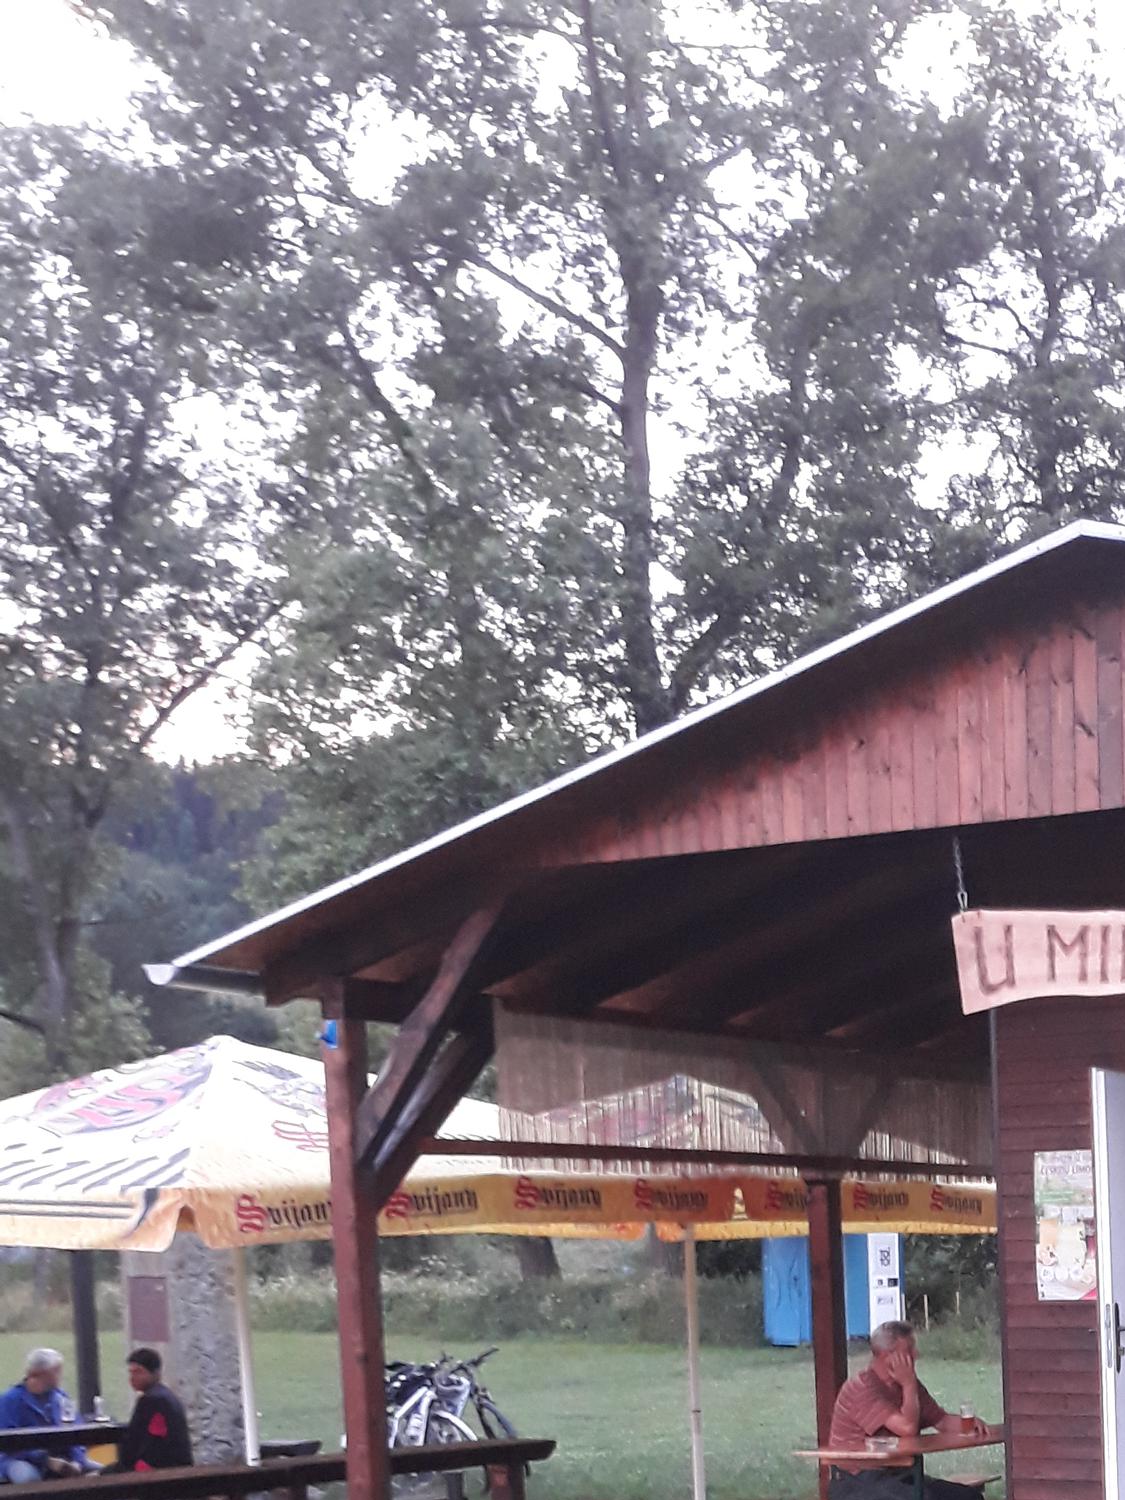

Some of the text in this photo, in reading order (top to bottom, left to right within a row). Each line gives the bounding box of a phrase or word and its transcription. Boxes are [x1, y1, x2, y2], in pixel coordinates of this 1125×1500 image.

[974, 924, 1016, 995] U
[515, 1175, 603, 1211] Svijany
[635, 1178, 709, 1210] Svijany
[853, 1182, 909, 1212] Svijany
[237, 1193, 333, 1233] Svijan
